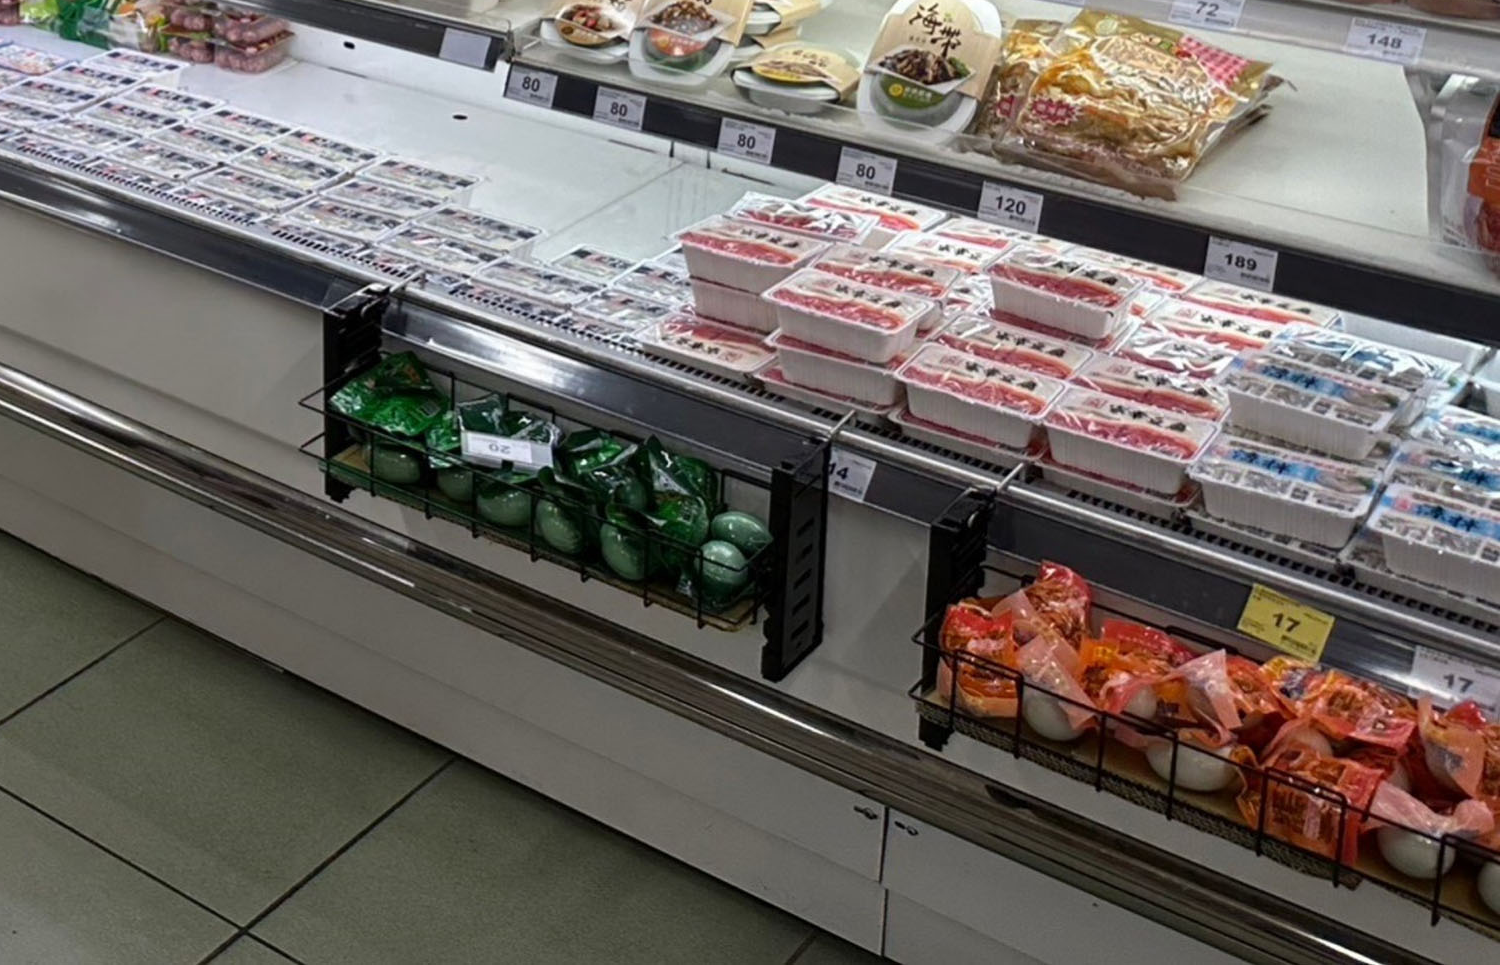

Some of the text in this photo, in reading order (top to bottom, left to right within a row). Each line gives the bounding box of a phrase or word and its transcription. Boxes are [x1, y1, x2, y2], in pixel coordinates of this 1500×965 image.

[1195, 1, 1220, 17] 72
[908, 2, 963, 59] 海帶
[1366, 35, 1403, 50] 148
[521, 75, 540, 92] 80
[610, 100, 629, 117] 80
[736, 132, 756, 149] 80
[856, 163, 877, 180] 80
[994, 196, 1026, 216] 120
[1223, 252, 1258, 272] 189
[1270, 610, 1301, 633] 17
[1441, 672, 1474, 694] 17
